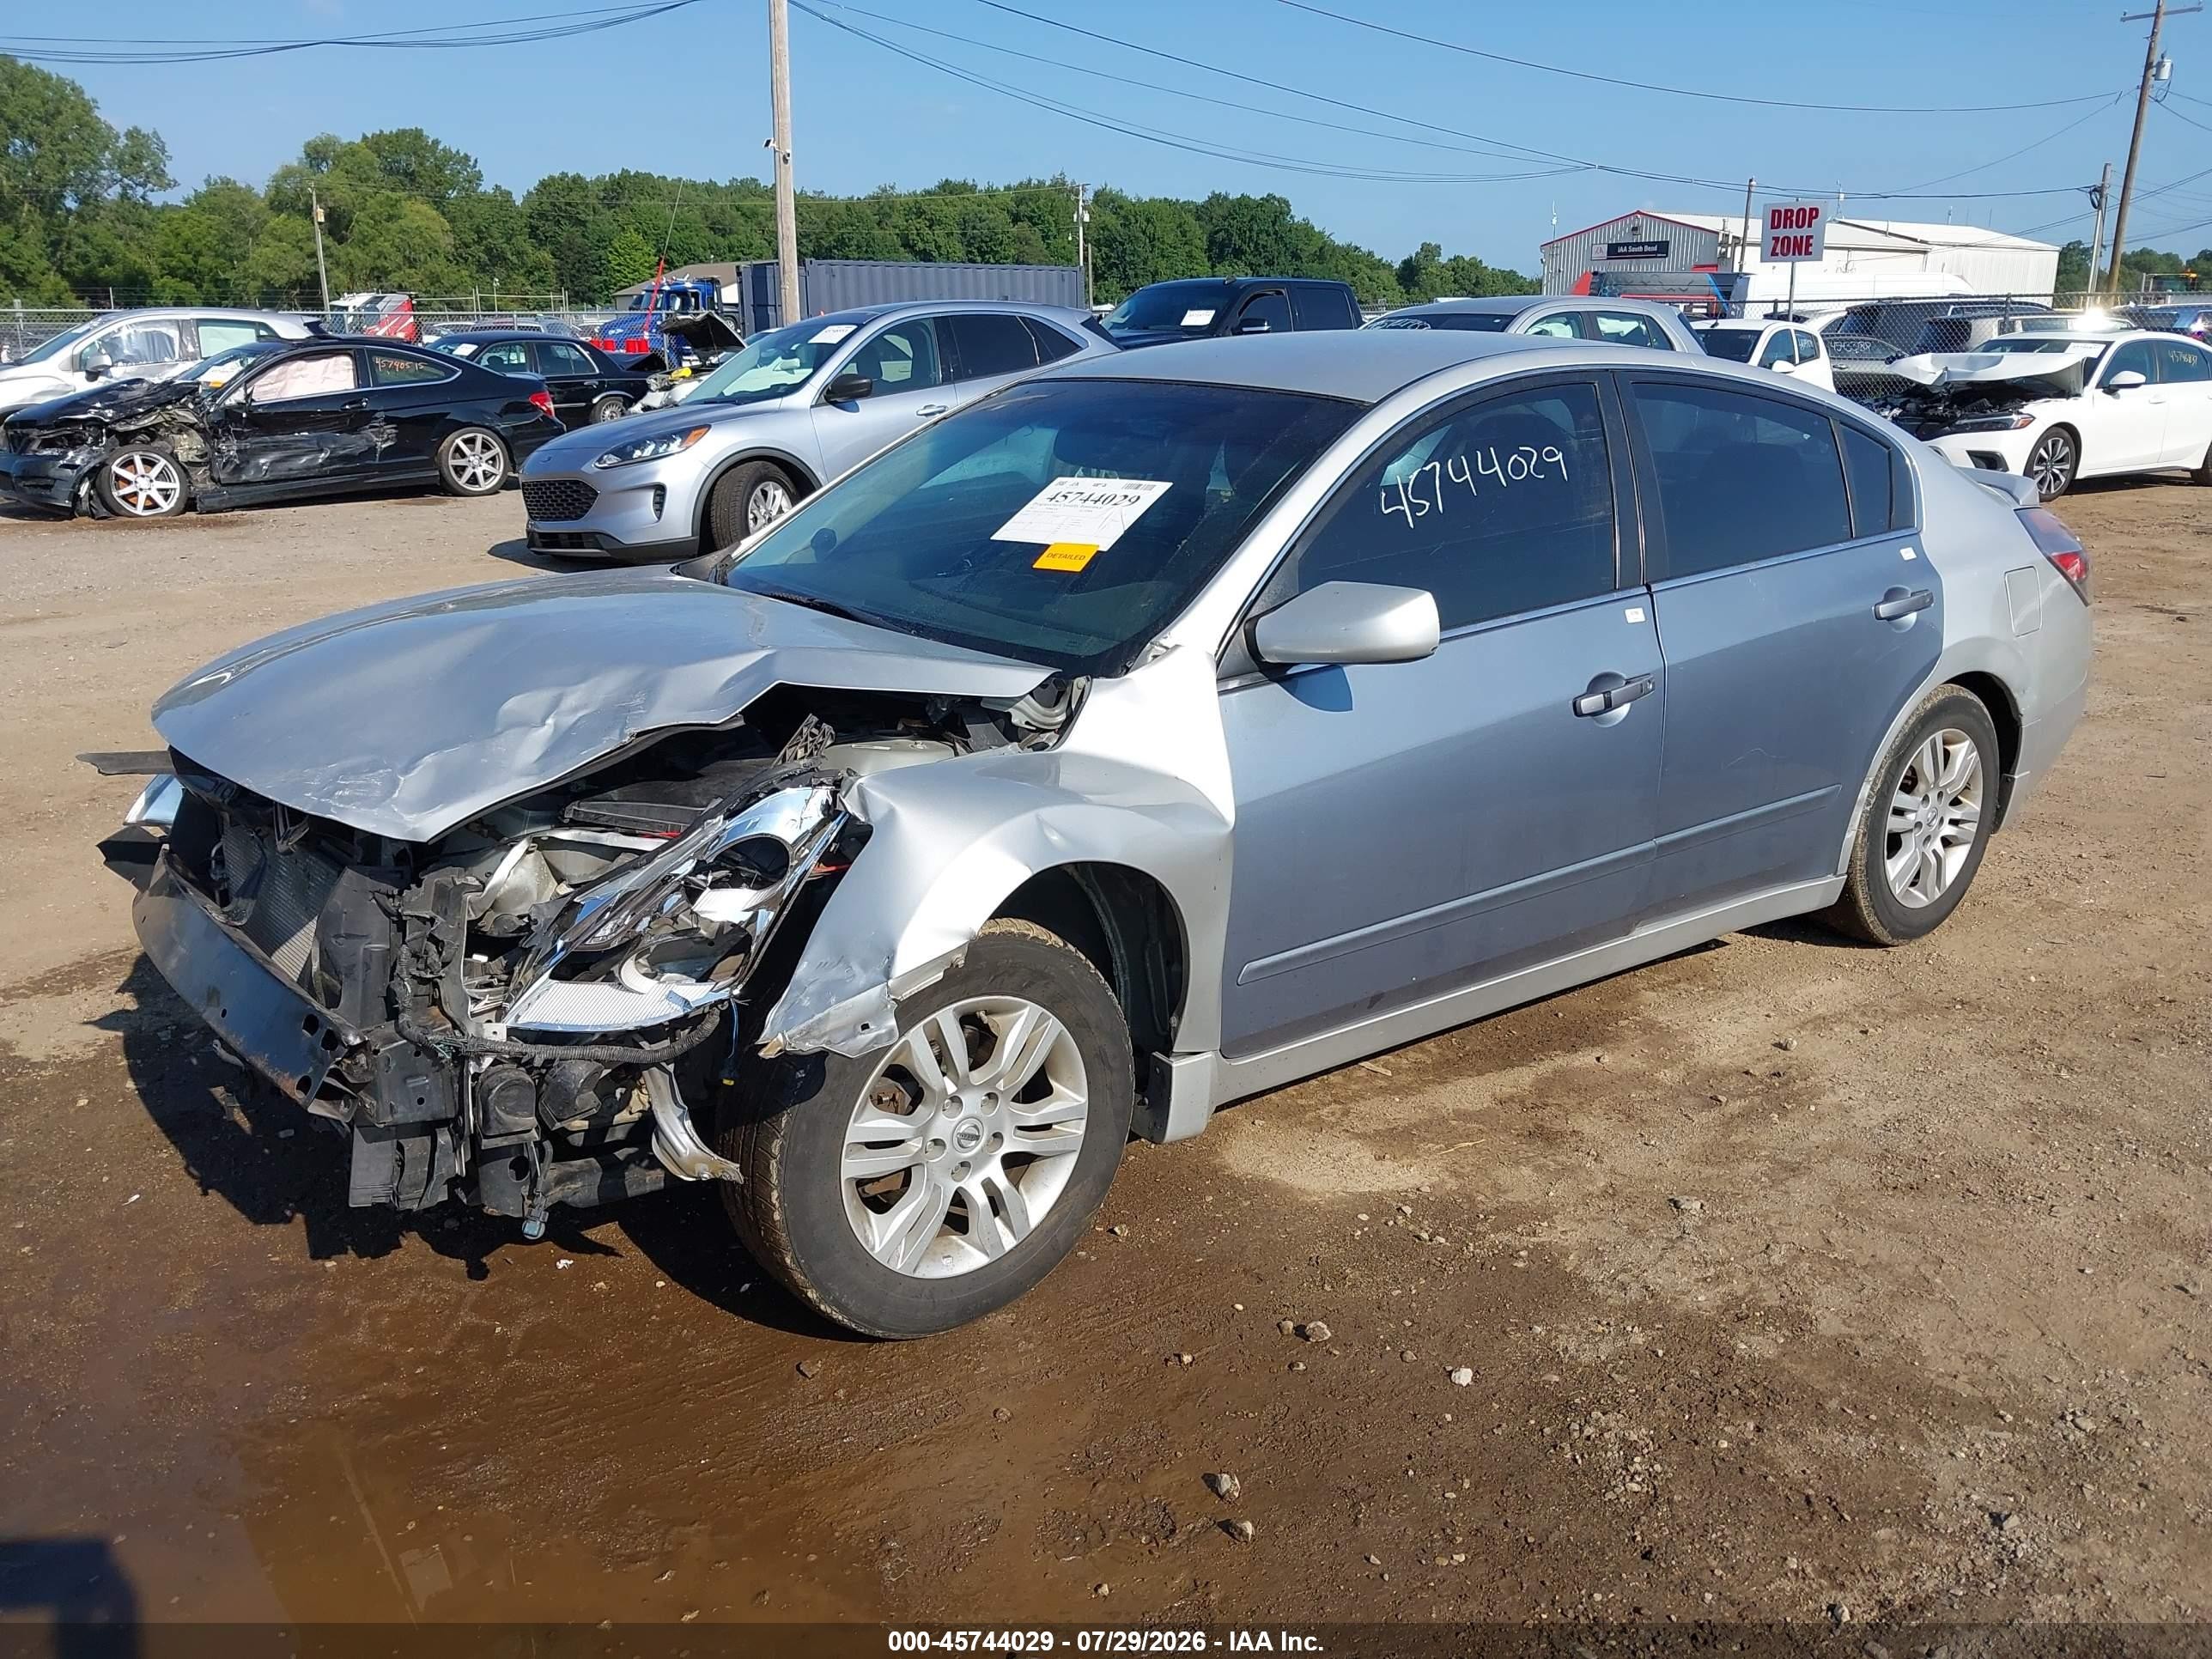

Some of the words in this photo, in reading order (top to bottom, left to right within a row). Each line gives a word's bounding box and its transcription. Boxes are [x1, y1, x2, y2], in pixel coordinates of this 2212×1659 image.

[1771, 207, 1820, 230] DROP
[1771, 234, 1814, 257] ZONE
[1047, 490, 1141, 507] 45744029
[1380, 447, 1568, 530] 45744029
[1046, 552, 1085, 561] DETAILED
